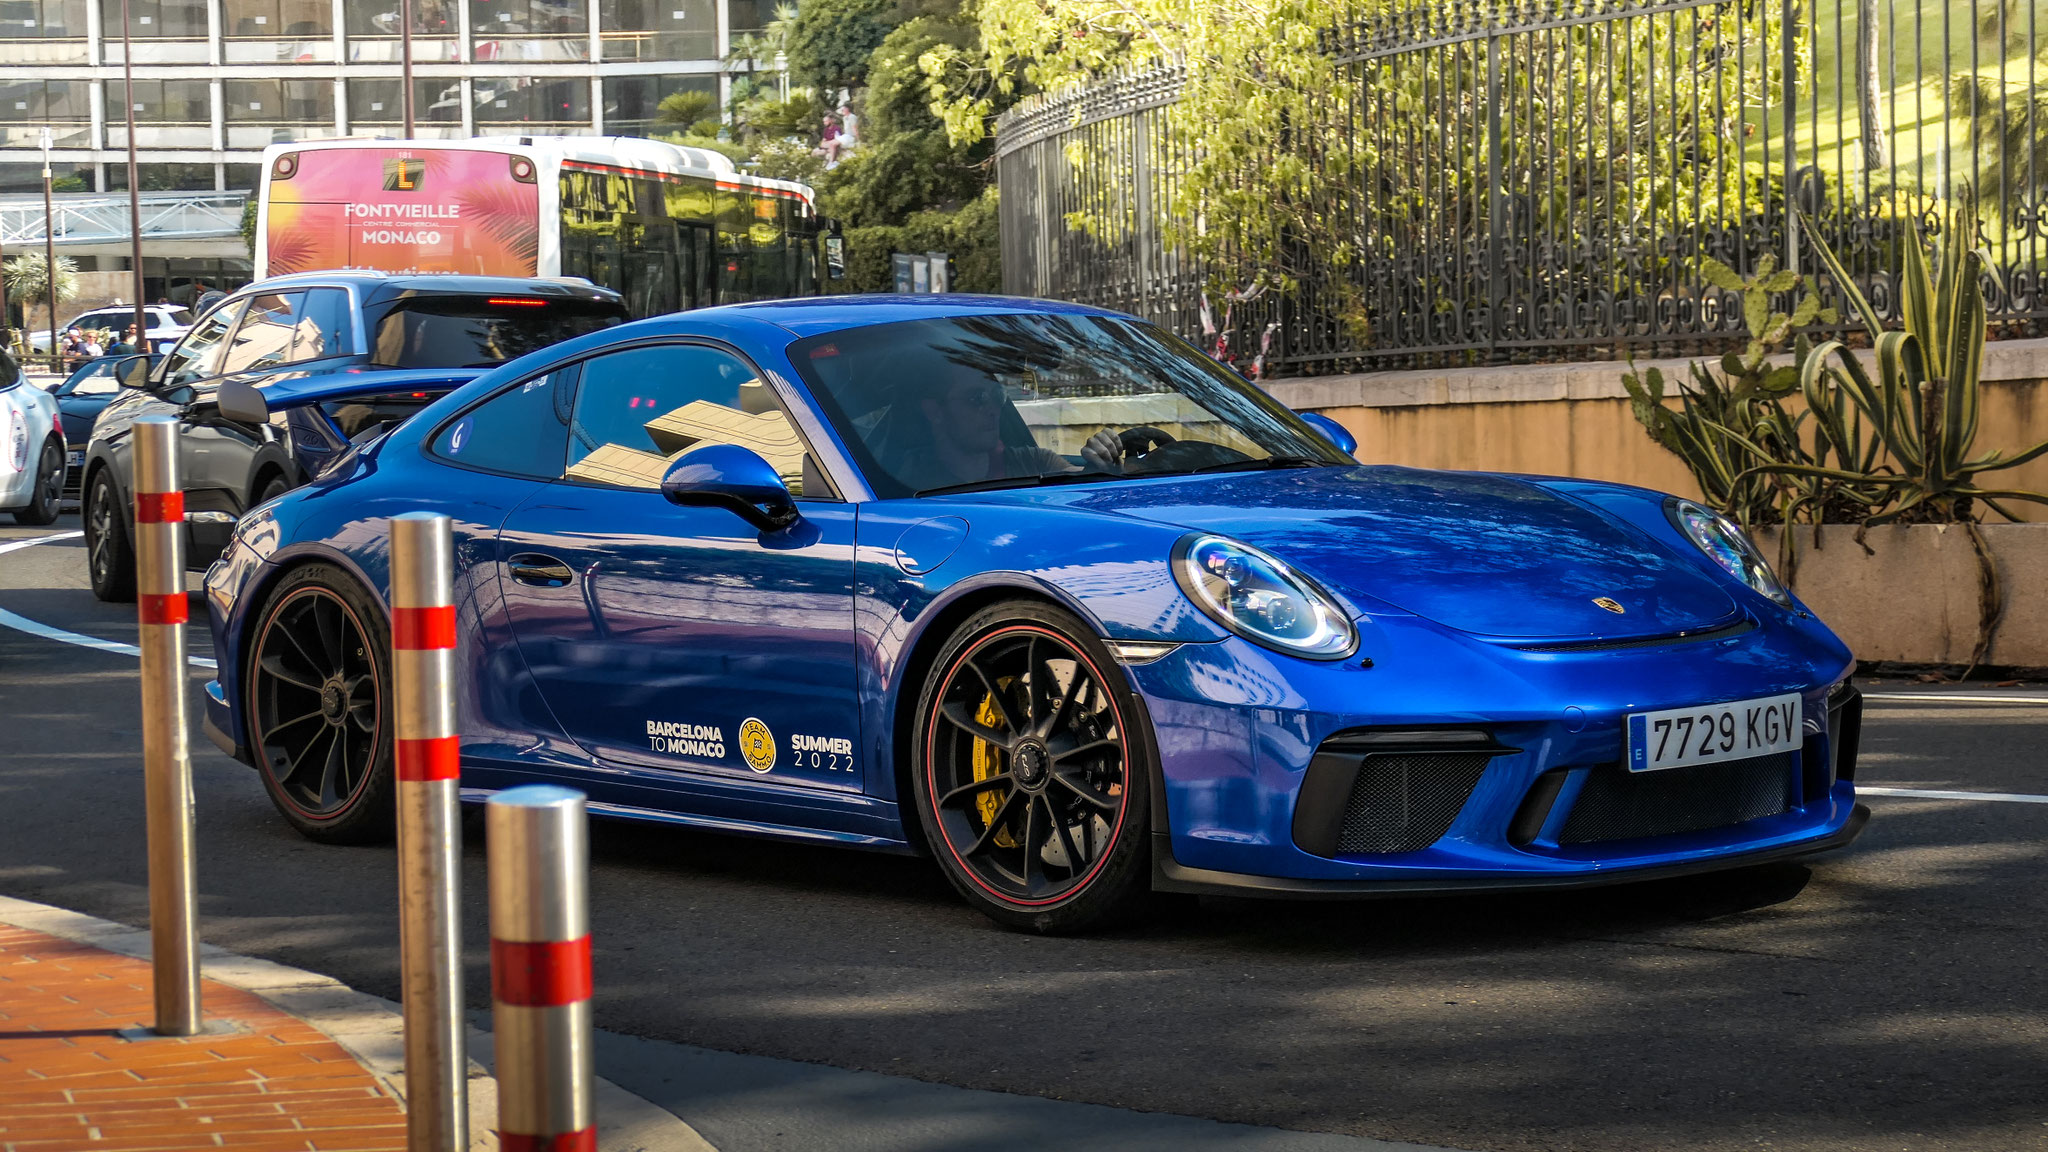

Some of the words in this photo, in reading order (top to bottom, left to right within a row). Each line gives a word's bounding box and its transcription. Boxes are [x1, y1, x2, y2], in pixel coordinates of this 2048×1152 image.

[398, 161, 414, 189] L
[344, 203, 460, 218] FONTVIEILLE
[362, 230, 441, 245] MONACO
[646, 720, 723, 742] BARCELONA
[745, 722, 766, 736] TEAM
[1654, 711, 1735, 762] 7729
[1746, 701, 1795, 749] KGV
[649, 736, 666, 752] TO
[667, 738, 726, 758] MONACO
[791, 734, 852, 755] SUMMER
[1635, 748, 1642, 761] E
